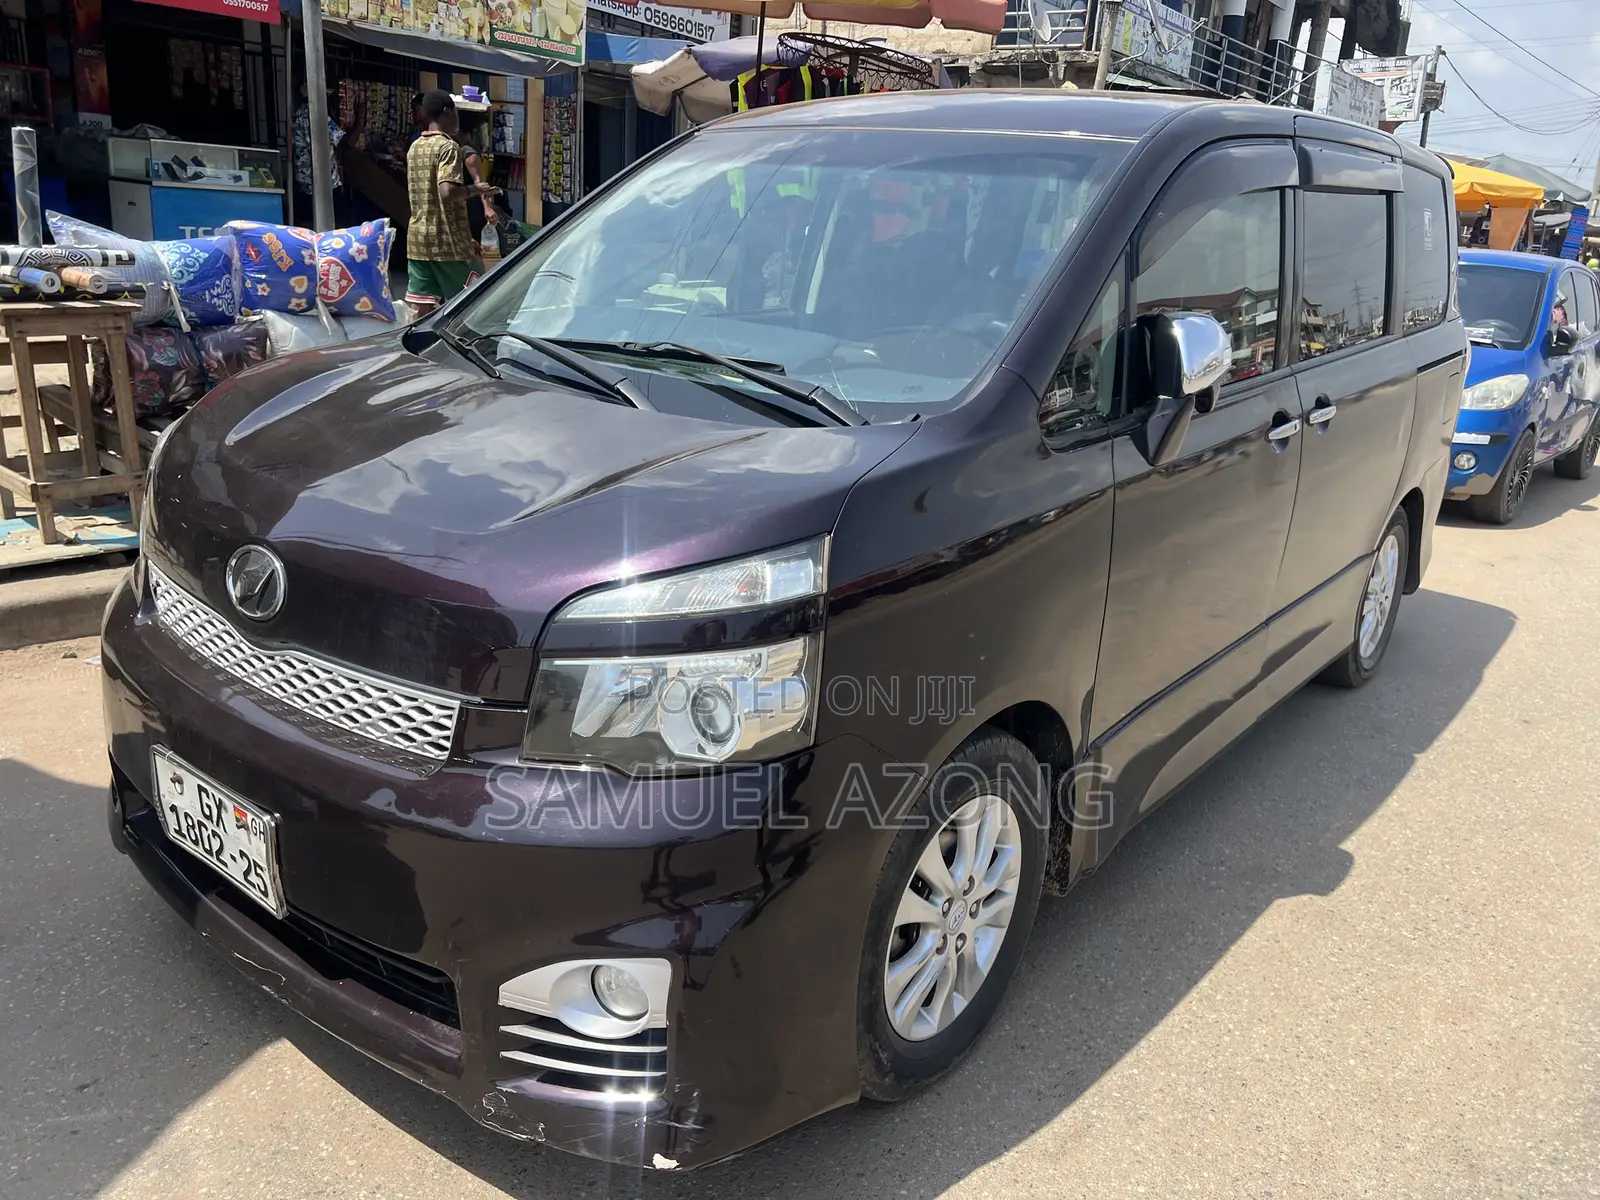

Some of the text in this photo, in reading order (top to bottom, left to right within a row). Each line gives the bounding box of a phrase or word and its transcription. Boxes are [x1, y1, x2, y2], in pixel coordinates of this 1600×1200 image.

[644, 6, 715, 41] 0596601517
[262, 232, 294, 272] KISS
[197, 783, 267, 844] GX GH
